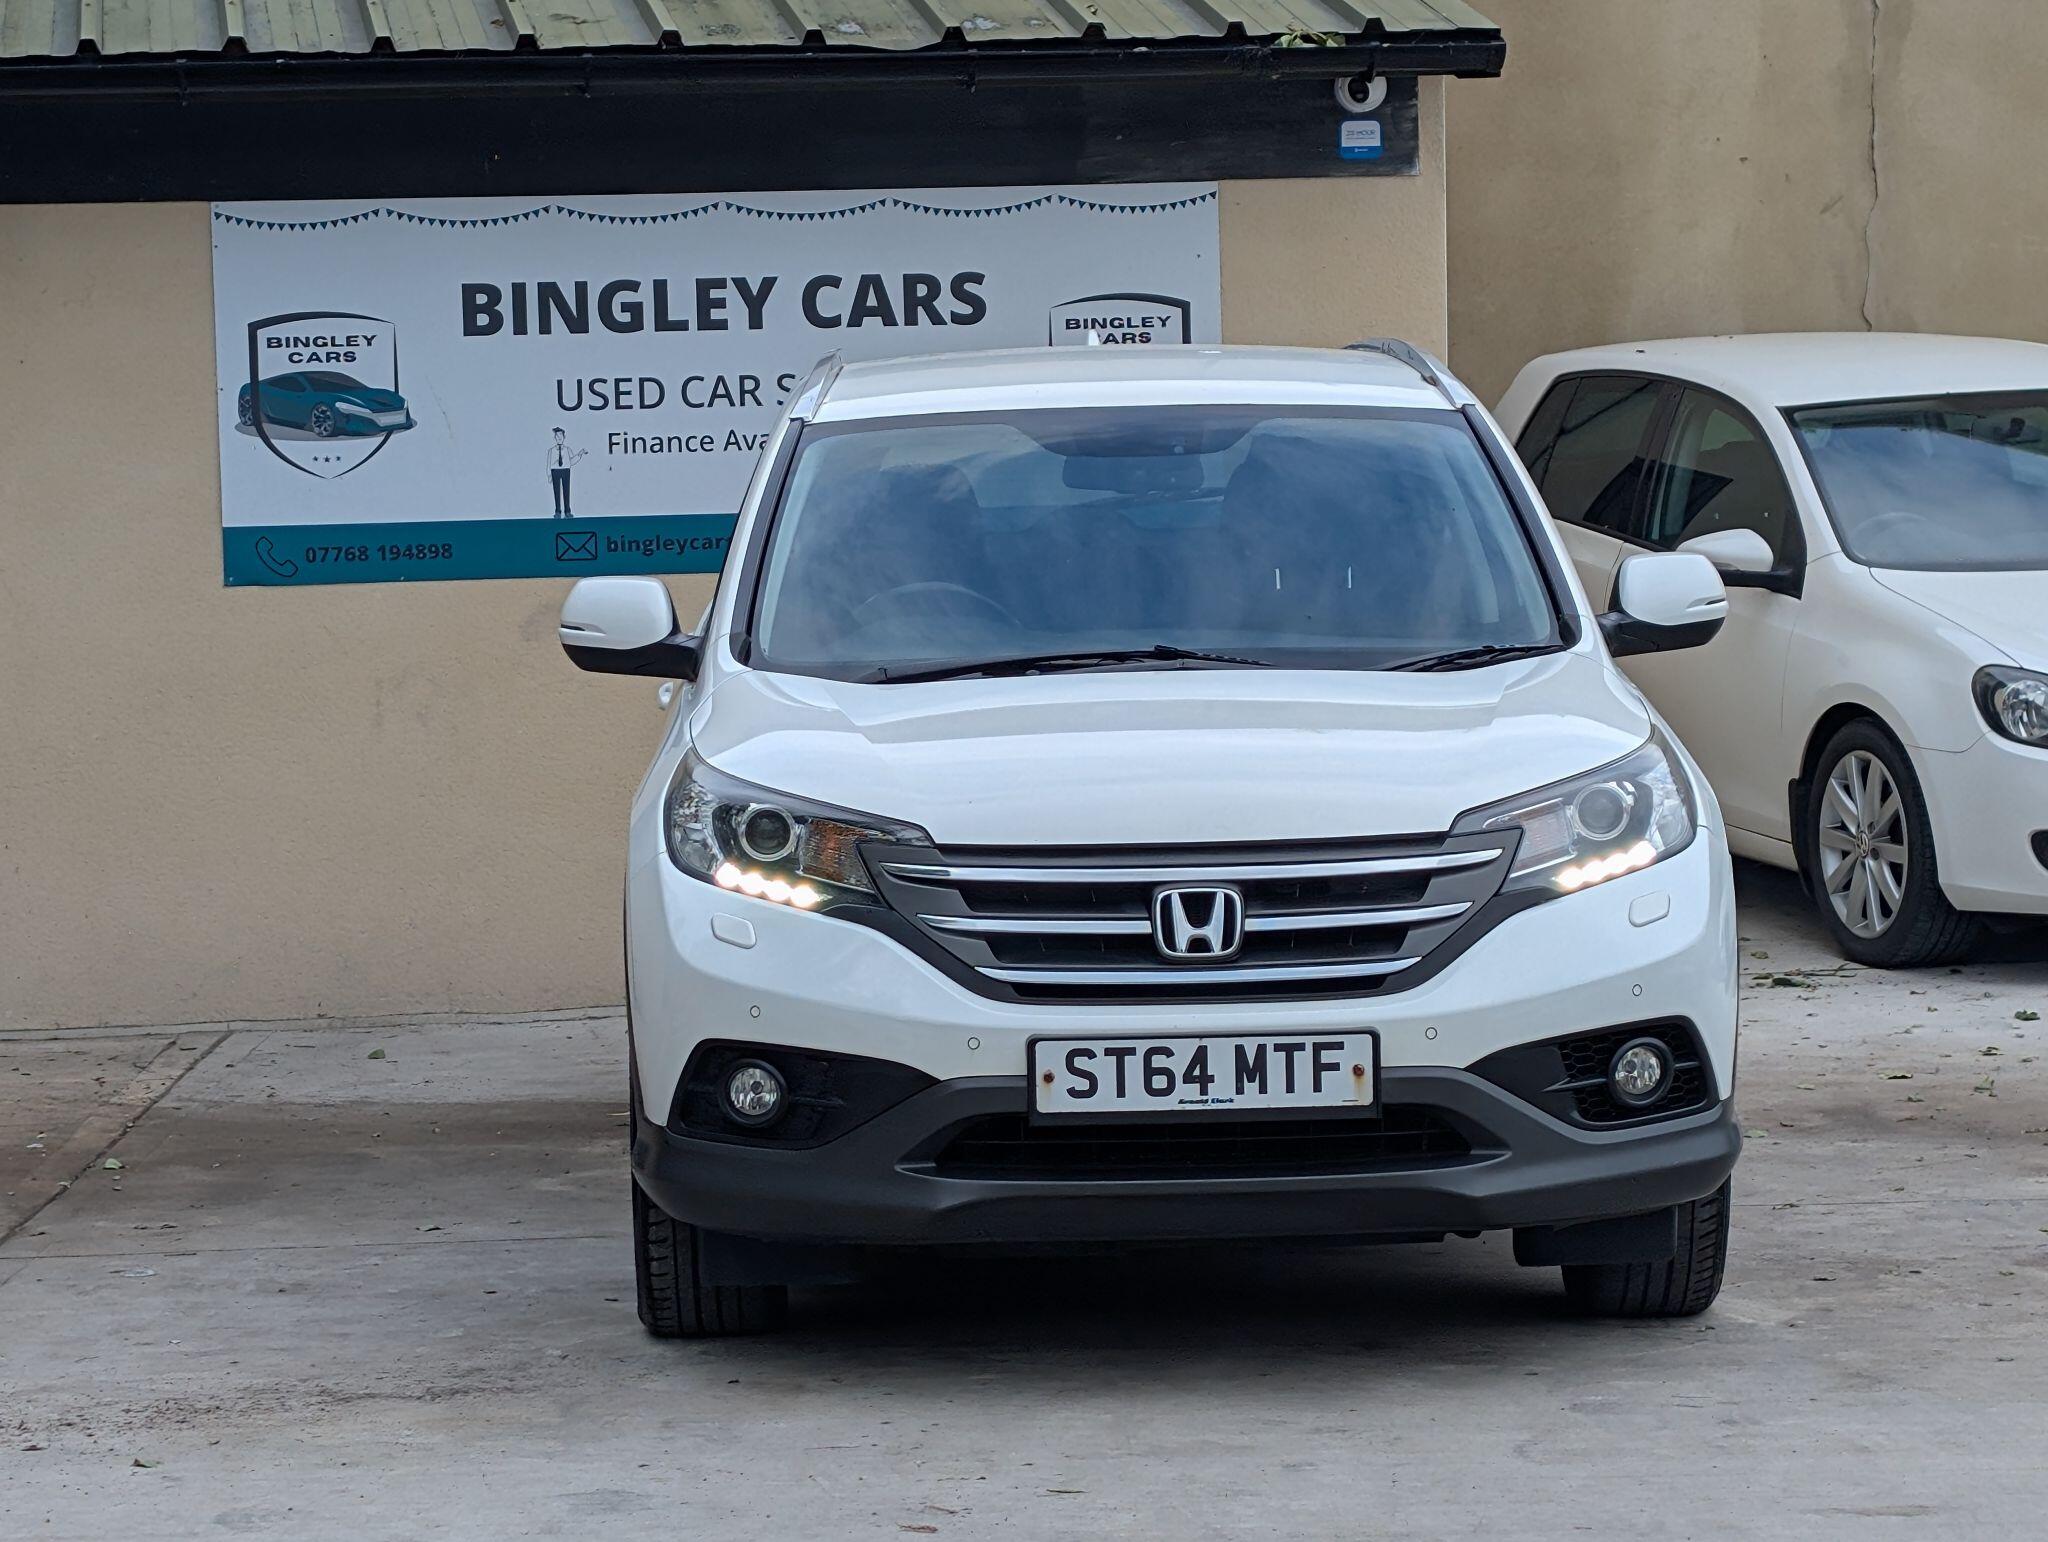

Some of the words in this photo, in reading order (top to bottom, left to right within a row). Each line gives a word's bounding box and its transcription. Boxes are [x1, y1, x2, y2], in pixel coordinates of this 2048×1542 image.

[461, 276, 778, 337] BINGLEY
[801, 271, 987, 329] CARS
[1065, 315, 1172, 330] BINGLEY
[266, 334, 377, 349] BINGLEY
[1098, 331, 1152, 345] ARS
[288, 351, 357, 364] CARS
[556, 377, 666, 412] USED
[681, 375, 764, 409] CAR
[608, 432, 715, 455] Finance
[305, 545, 369, 564] 07768
[377, 543, 453, 561] 194898
[606, 534, 732, 557] bingleycar
[1065, 1044, 1215, 1099] ST64
[1234, 1041, 1345, 1095] MTF
